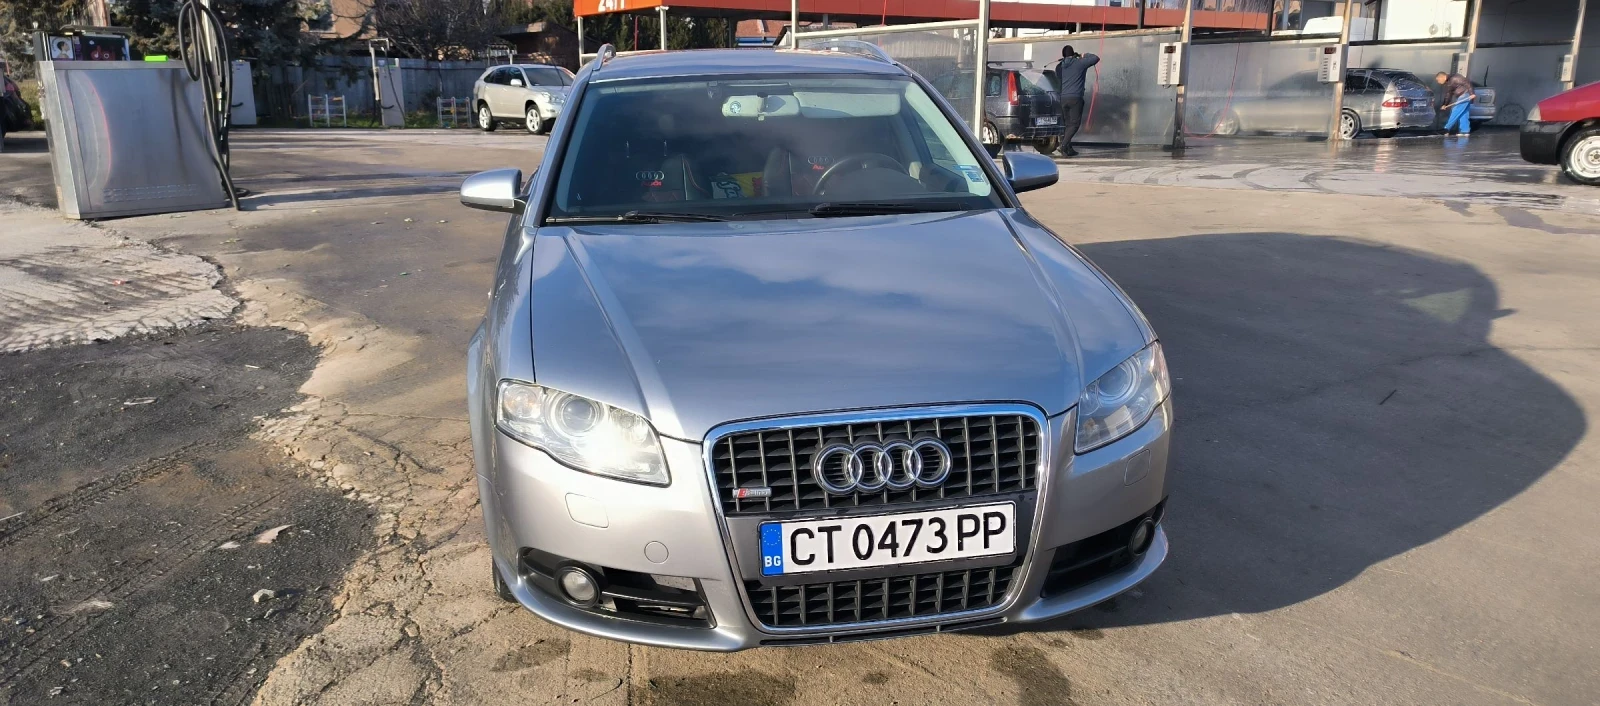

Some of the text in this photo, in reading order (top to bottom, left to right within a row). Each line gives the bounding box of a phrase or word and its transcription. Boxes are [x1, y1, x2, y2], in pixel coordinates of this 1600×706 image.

[790, 511, 1007, 566] CT 0473 PP
[764, 555, 782, 568] BG
